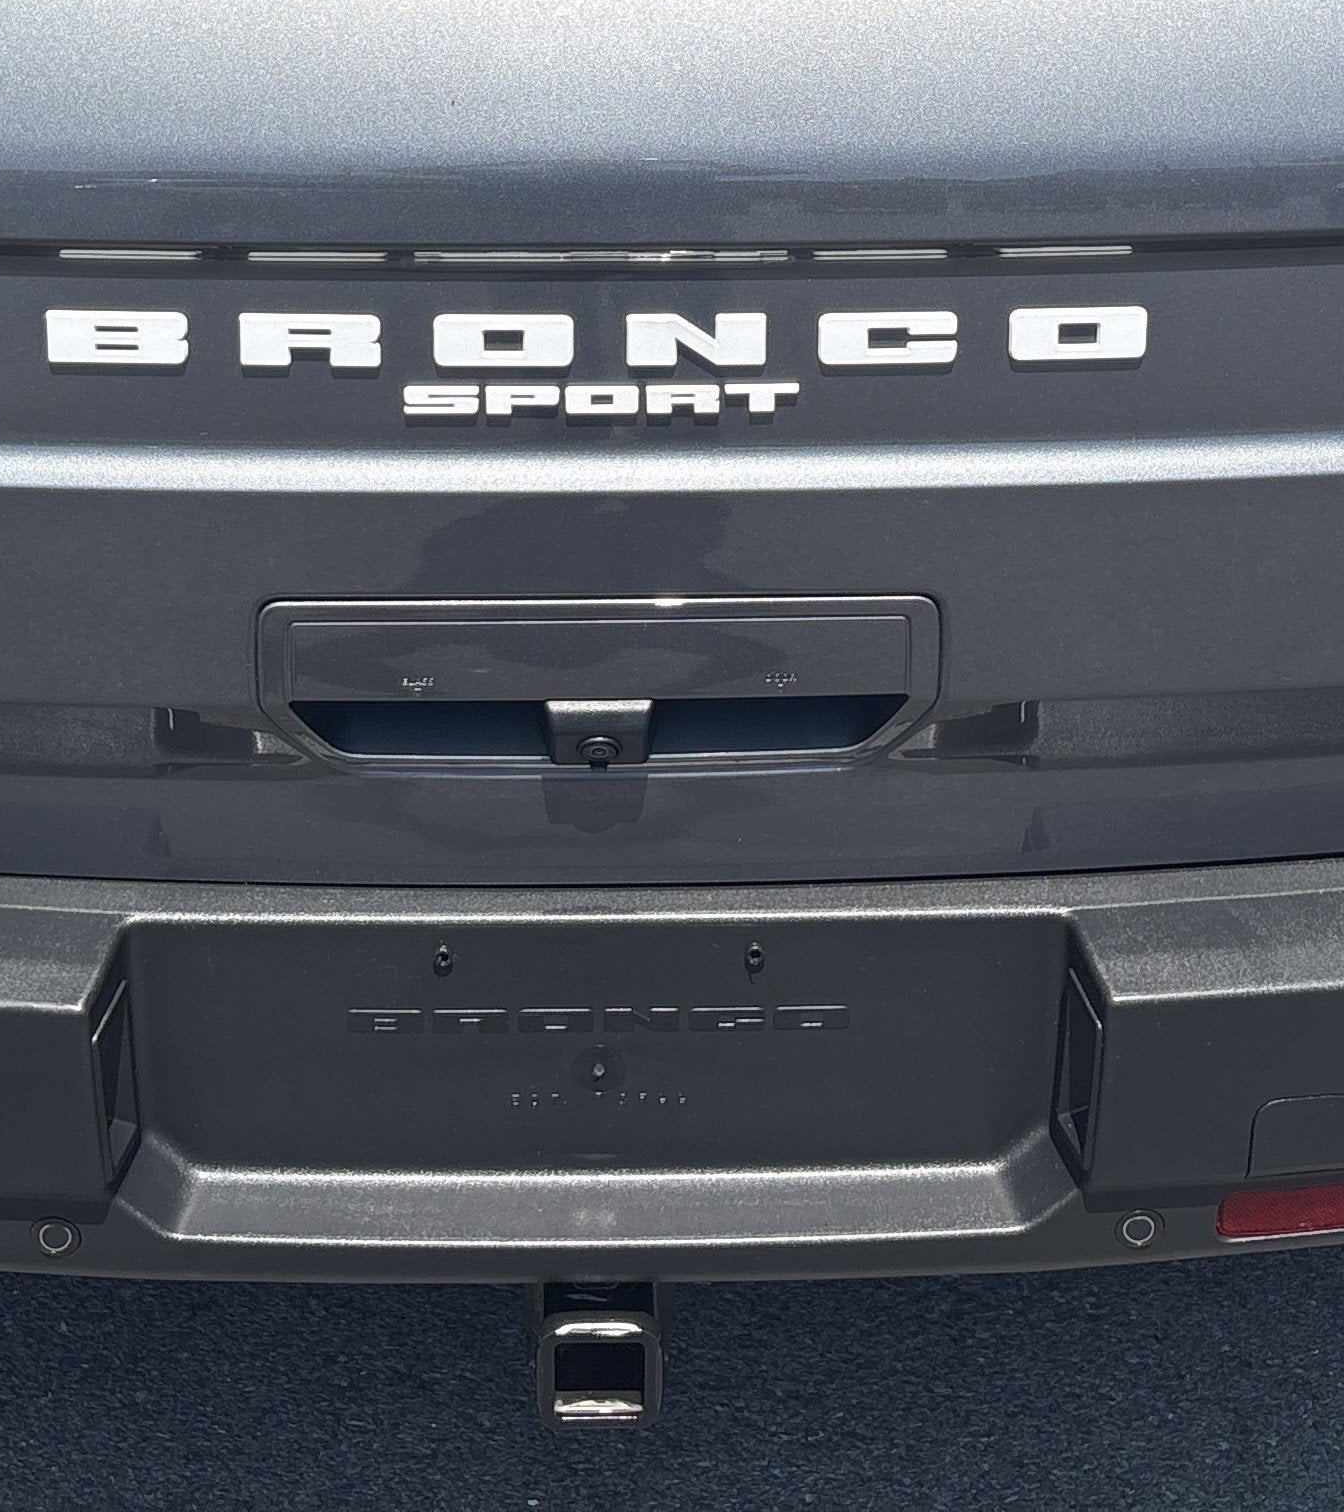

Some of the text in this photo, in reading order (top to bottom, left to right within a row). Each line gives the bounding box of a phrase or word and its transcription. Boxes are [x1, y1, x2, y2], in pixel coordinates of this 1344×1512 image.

[45, 305, 1148, 368] BRONCO
[402, 382, 800, 416] SPORT
[347, 1004, 850, 1033] BRONCO
